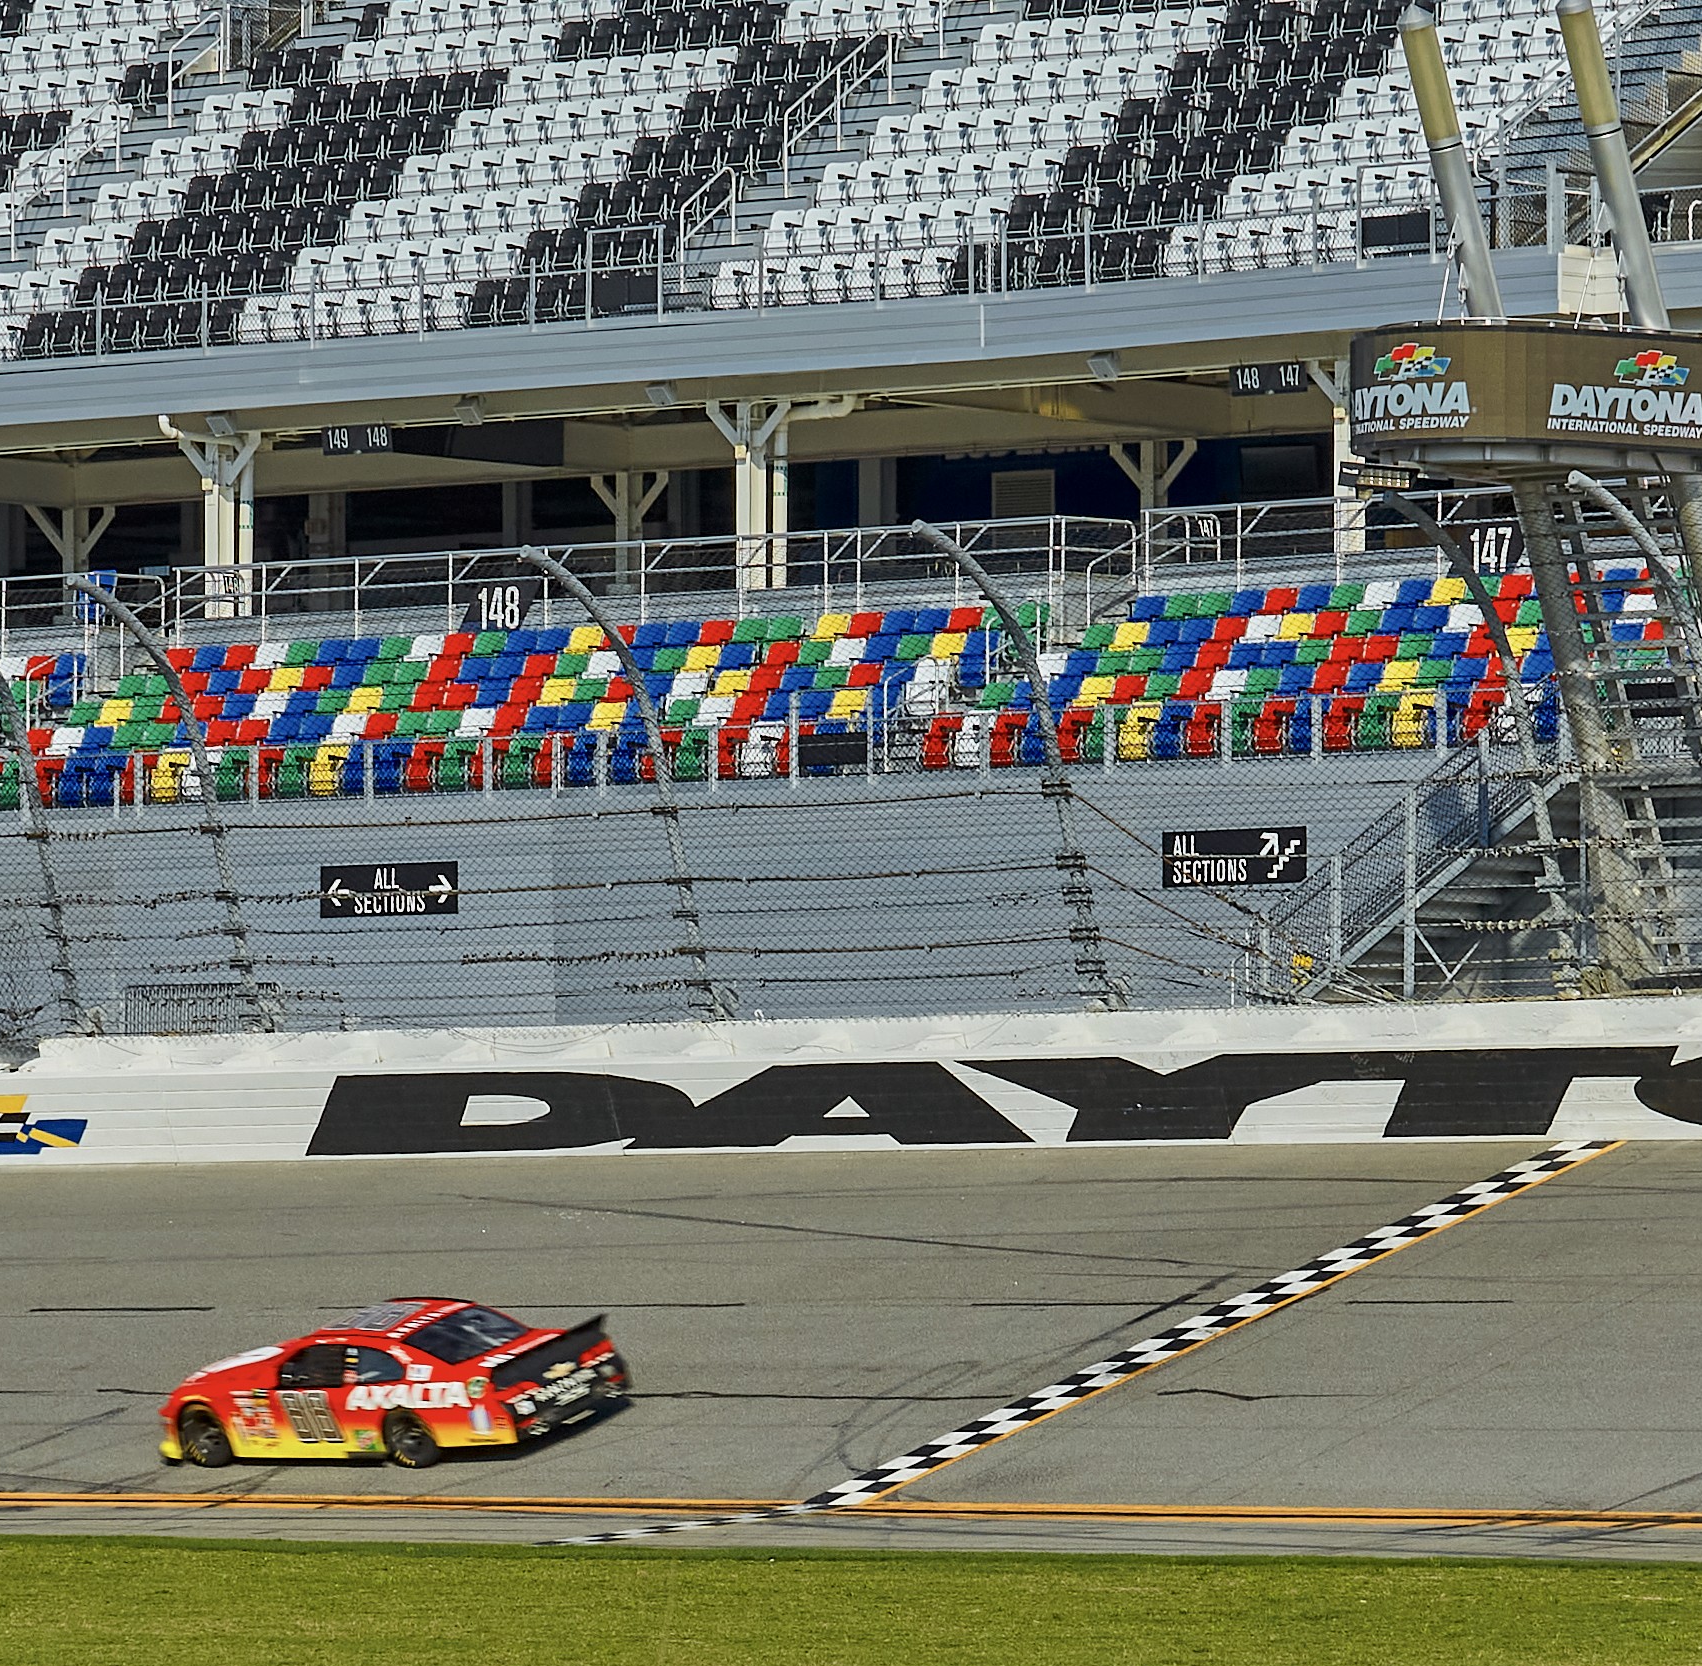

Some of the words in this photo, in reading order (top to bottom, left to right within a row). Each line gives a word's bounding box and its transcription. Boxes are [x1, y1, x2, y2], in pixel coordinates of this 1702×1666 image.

[1236, 367, 1259, 390] 148
[1279, 364, 1300, 387] 147
[1352, 381, 1471, 421] AYTONA
[1399, 416, 1470, 430] SPEEDWAY
[1547, 418, 1640, 435] INTERNATIONAL
[327, 428, 349, 449] 149
[366, 426, 388, 447] 148
[1197, 517, 1215, 538] 147
[1470, 528, 1512, 573] 147
[477, 586, 520, 630] 148
[1173, 834, 1199, 857] ALL
[374, 867, 400, 889] ALL
[1172, 858, 1247, 884] SECTIONS
[354, 892, 426, 914] SECTIONS
[346, 1381, 472, 1411] AXALTA
[276, 1389, 346, 1443] 88
